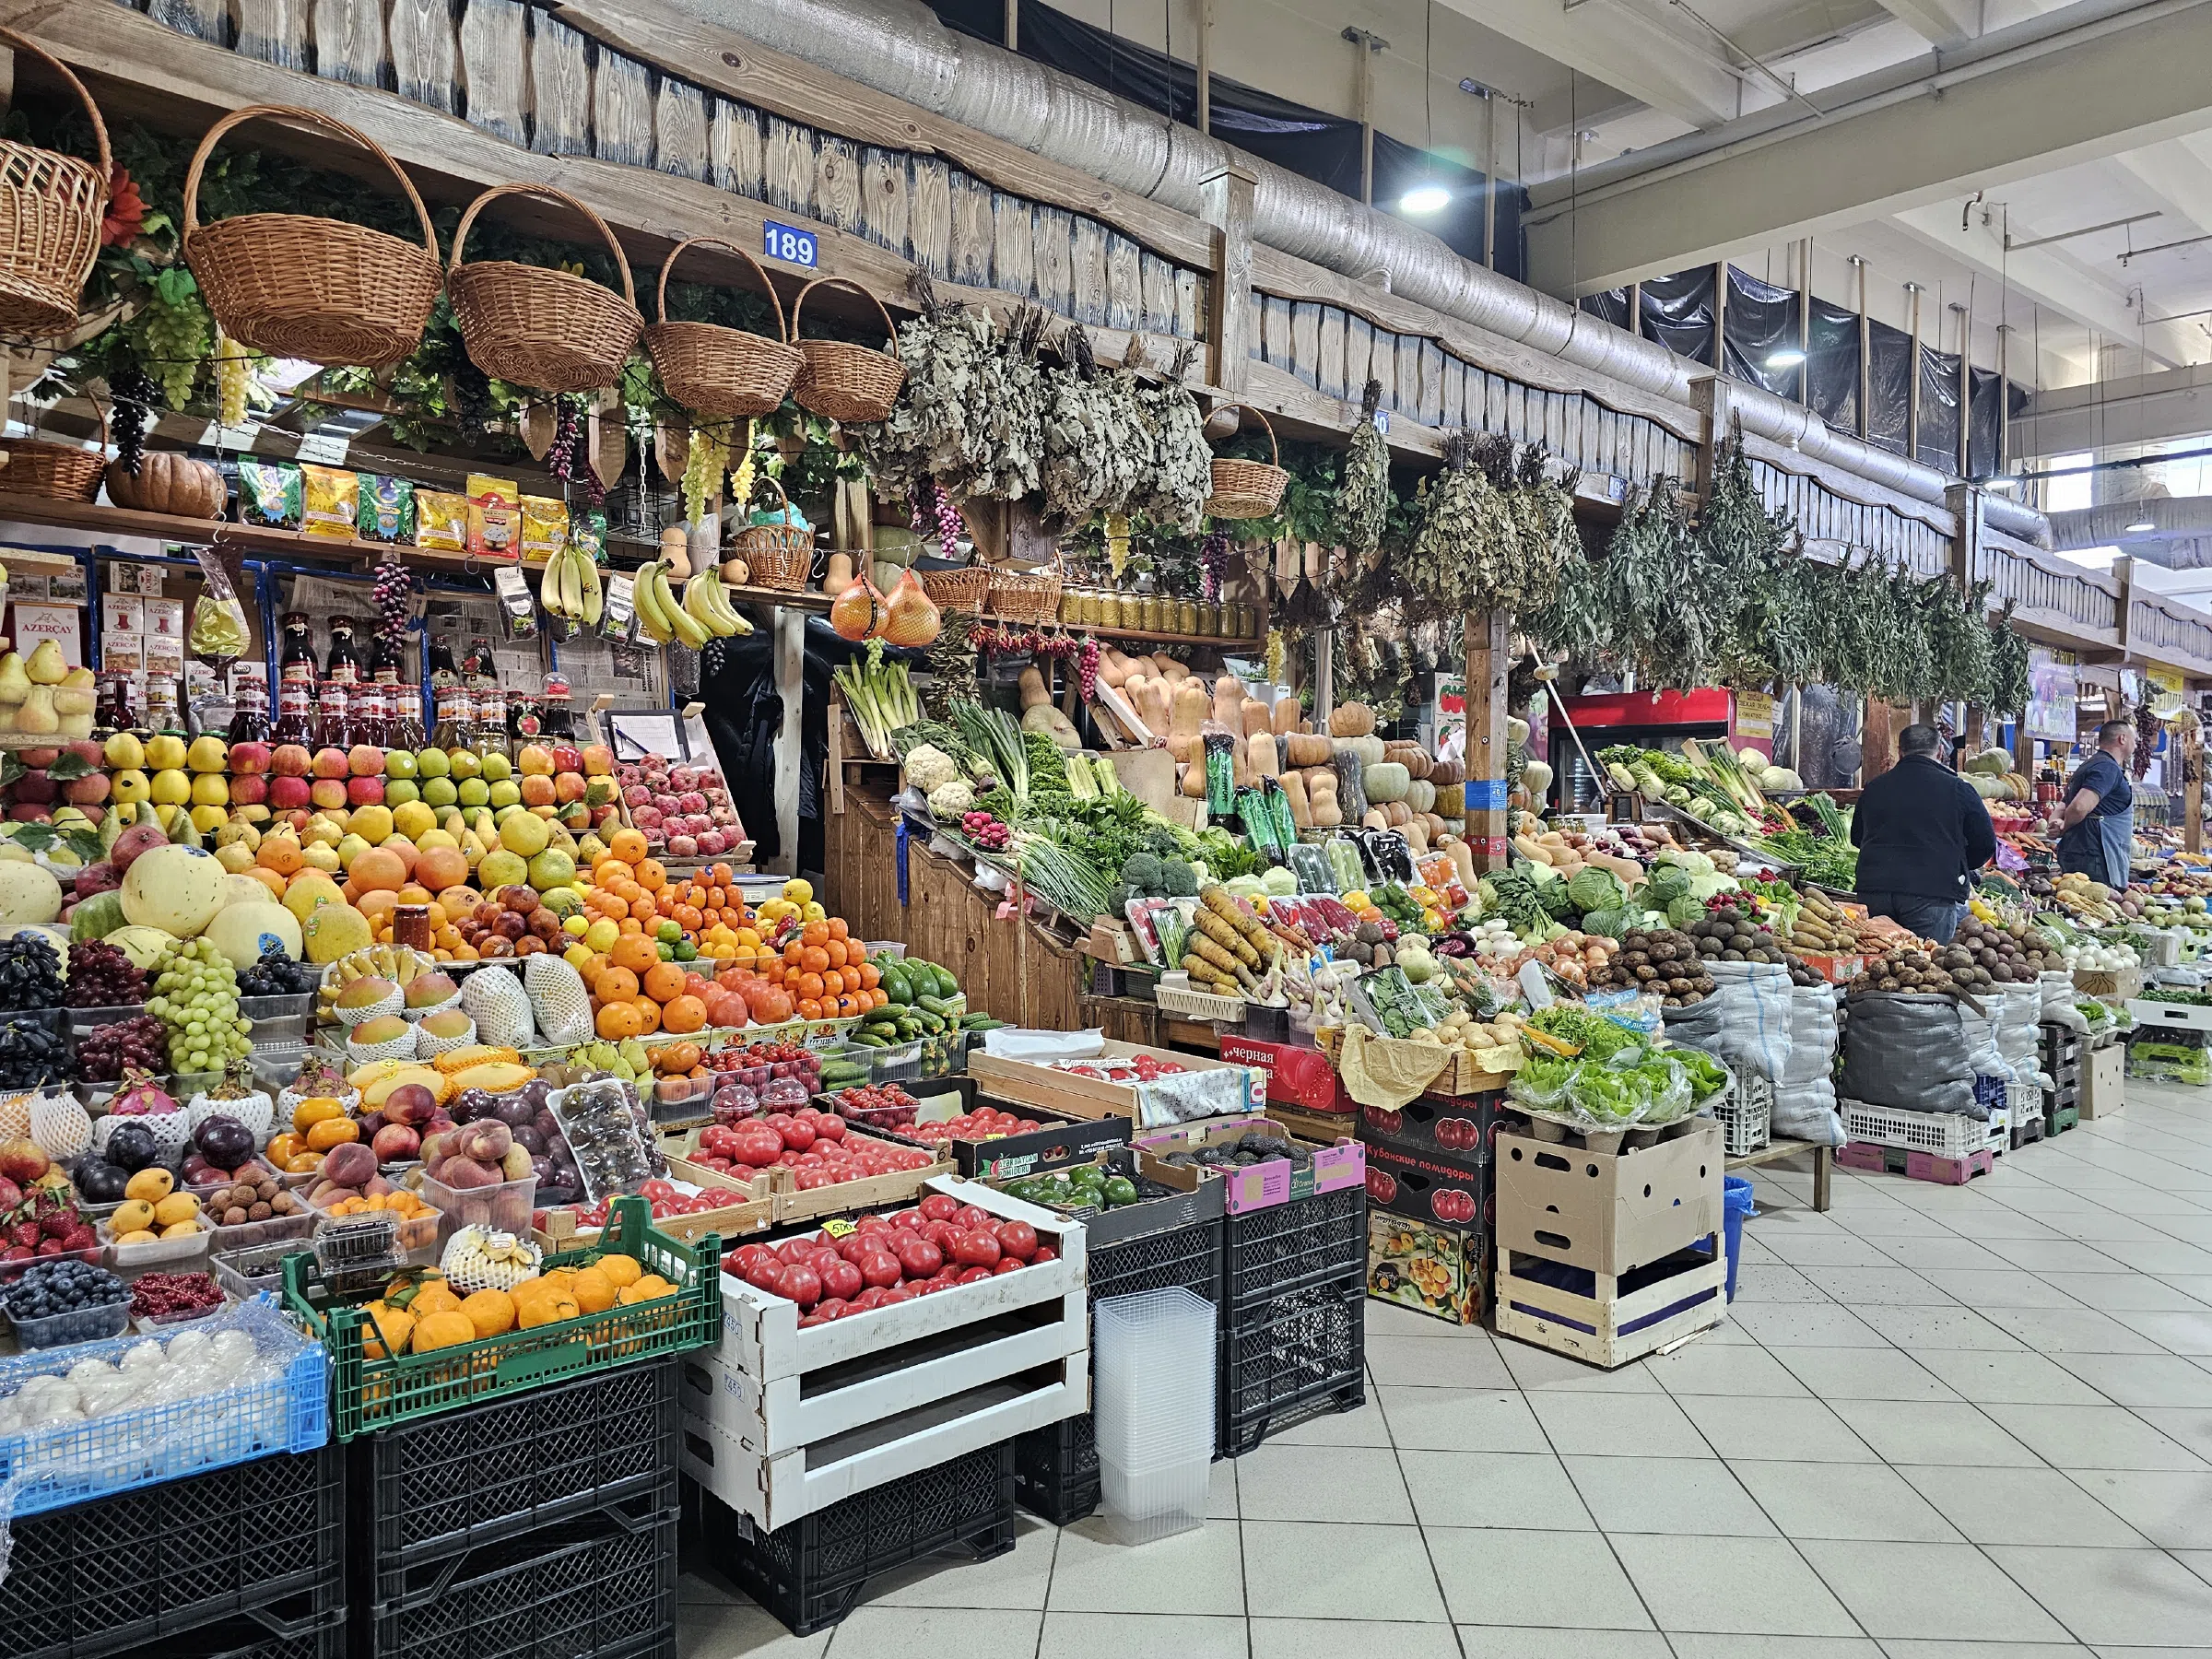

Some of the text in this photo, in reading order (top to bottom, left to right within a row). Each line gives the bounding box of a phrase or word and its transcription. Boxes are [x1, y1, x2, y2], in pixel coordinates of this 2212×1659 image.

[766, 229, 813, 264] 189
[64, 571, 83, 580] RÇAY
[108, 604, 137, 612] AZERÇAY
[22, 623, 74, 634] AZERÇAY
[807, 1036, 838, 1046] APRICOT
[1232, 1047, 1274, 1064] черная
[1424, 1091, 1477, 1110] помидоры
[937, 1145, 947, 1161] 6
[1366, 1144, 1417, 1166] Кубанские
[1418, 1160, 1474, 1181] помидоры
[832, 1223, 853, 1234] 500
[1374, 1214, 1412, 1231] Uzbekistan
[726, 1316, 739, 1335] 450
[728, 1382, 742, 1398] 450
